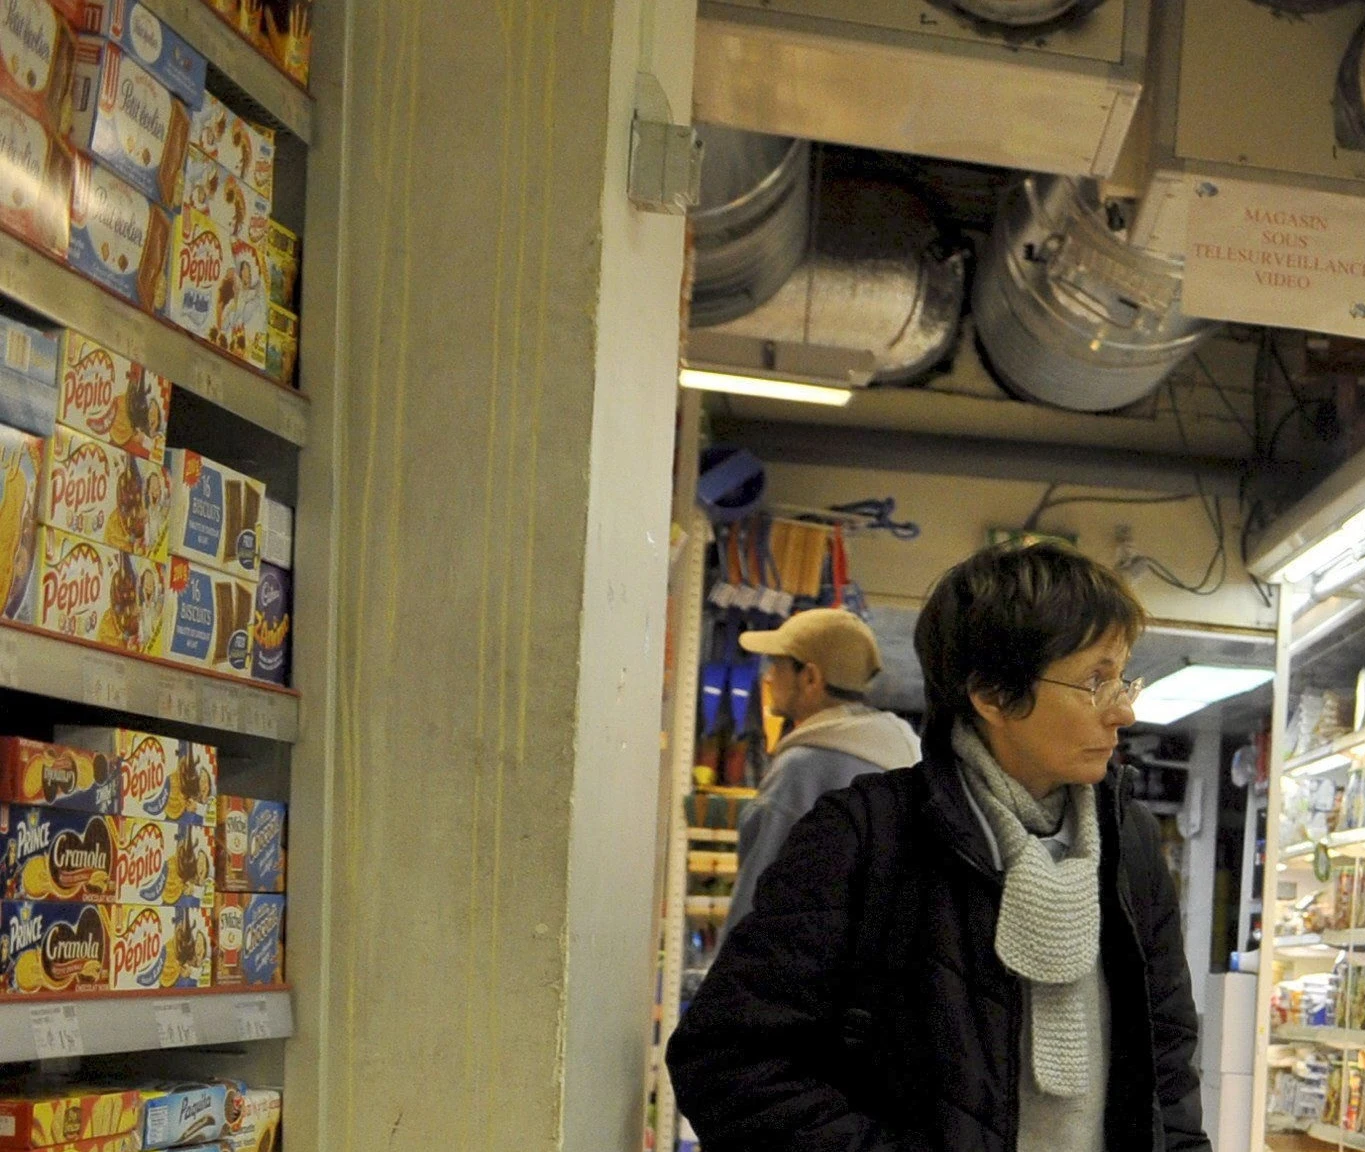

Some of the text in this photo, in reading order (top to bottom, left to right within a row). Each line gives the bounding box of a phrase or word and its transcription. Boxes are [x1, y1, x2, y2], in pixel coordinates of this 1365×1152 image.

[1245, 207, 1329, 230] MAGASIN
[1262, 230, 1309, 249] SOUS
[179, 247, 221, 289] Pépito
[1254, 271, 1311, 290] VIDEO
[63, 370, 112, 420] Pépito
[50, 466, 107, 520] Pépito
[42, 569, 101, 625] Pépito
[119, 758, 164, 802] Pépito
[53, 834, 107, 870] Granola
[118, 847, 162, 901] Pépito
[46, 925, 100, 960] Granola
[113, 930, 161, 989] Pépito
